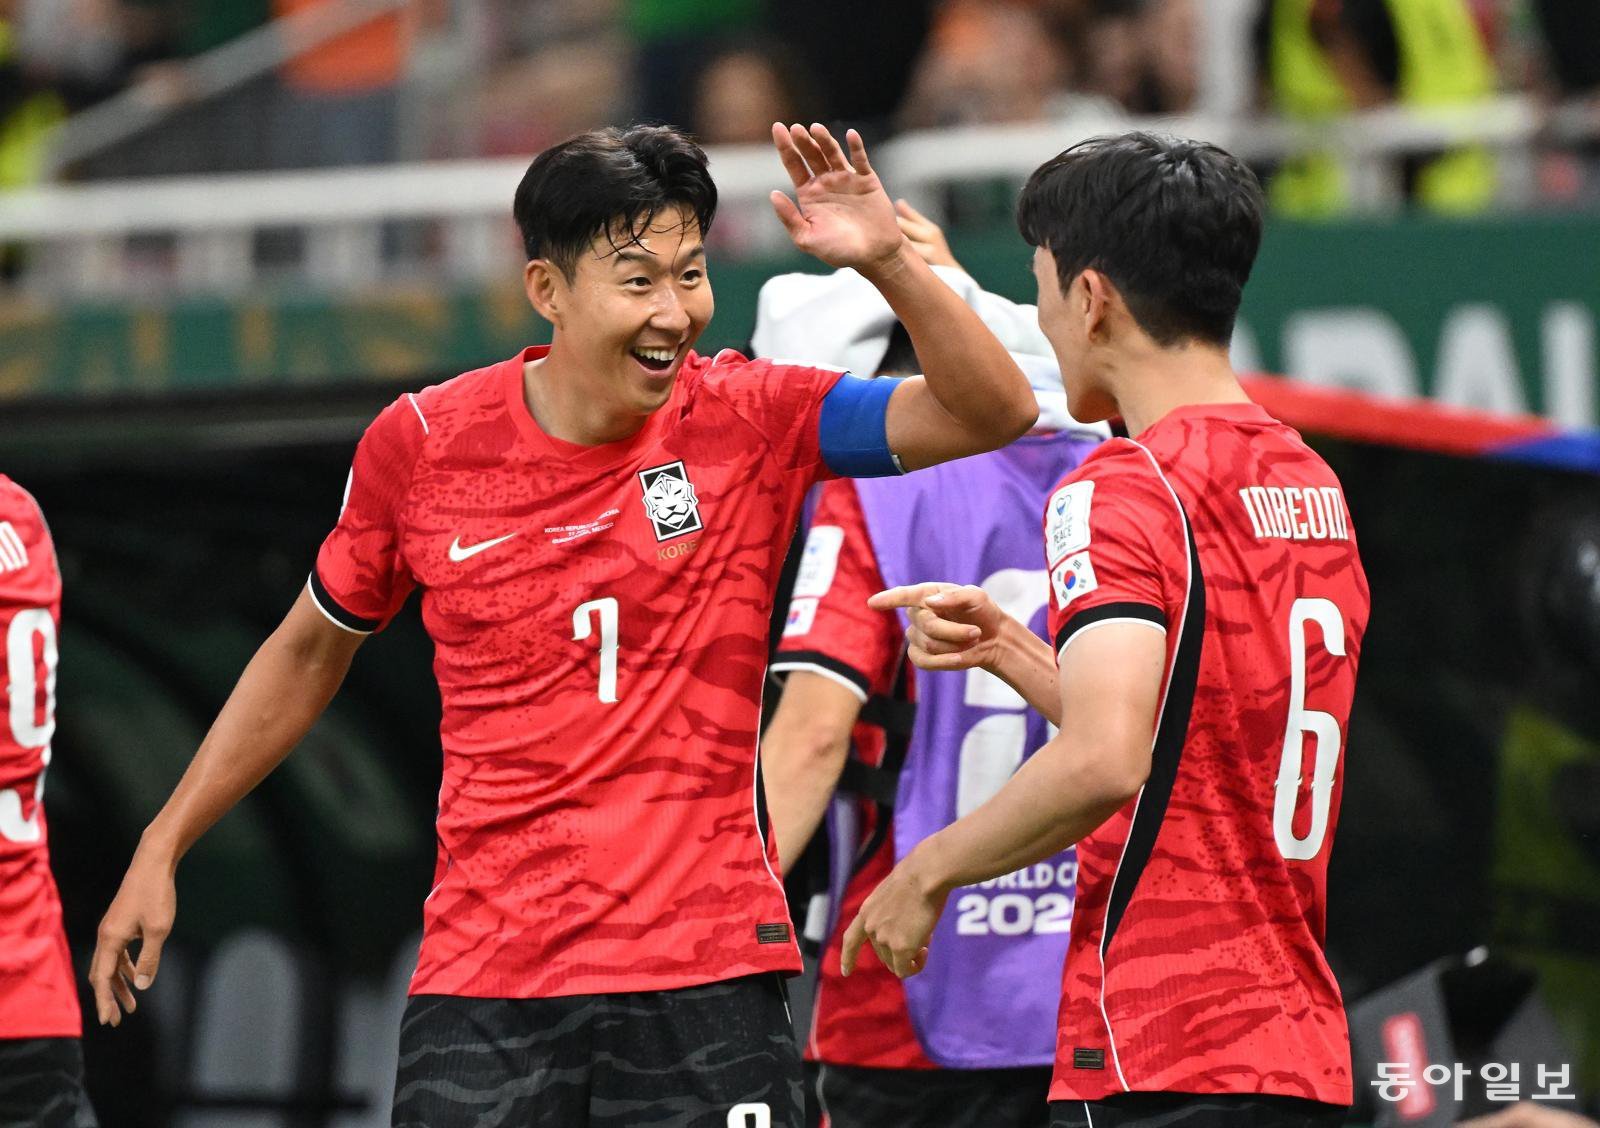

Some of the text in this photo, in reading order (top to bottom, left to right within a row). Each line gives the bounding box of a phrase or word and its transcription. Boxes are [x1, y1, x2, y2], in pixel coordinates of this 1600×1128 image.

[1239, 486, 1348, 540] INBEOM
[656, 540, 698, 561] KORE
[571, 597, 619, 703] 7
[1273, 597, 1347, 860] 6
[961, 862, 1054, 889] RLD
[956, 893, 1076, 936] 202
